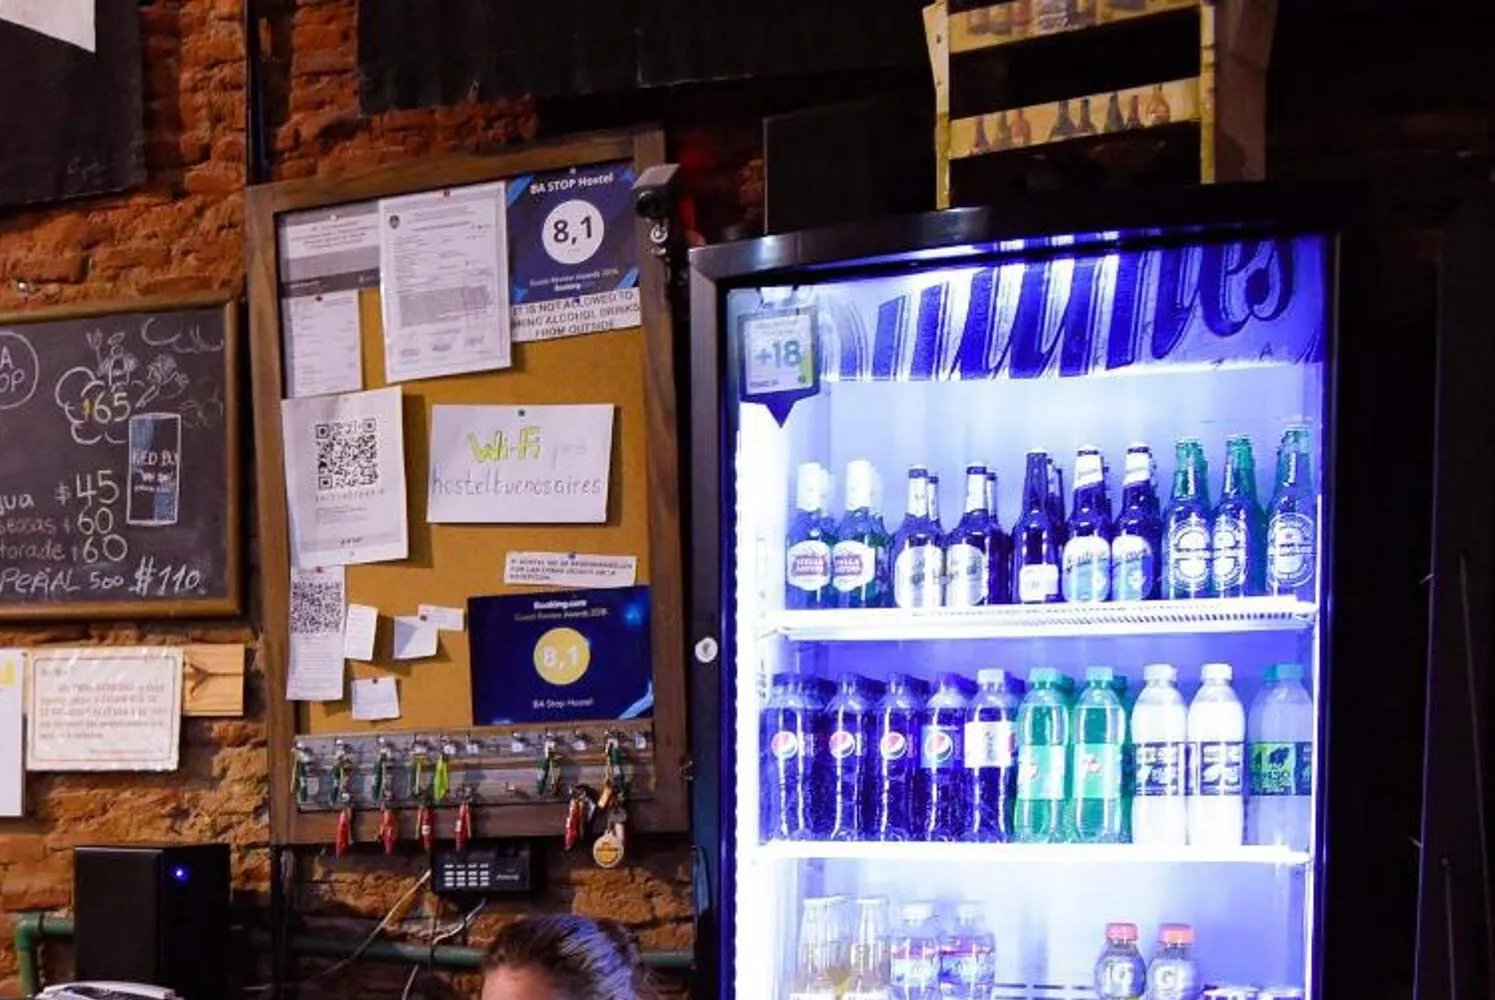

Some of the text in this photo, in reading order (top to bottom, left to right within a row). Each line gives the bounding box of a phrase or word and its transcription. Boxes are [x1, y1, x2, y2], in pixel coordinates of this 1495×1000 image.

[530, 172, 614, 195] BA STOP Hostel
[553, 215, 593, 246] 8,1
[754, 340, 802, 368] +18
[467, 427, 544, 463] Wi-Fi
